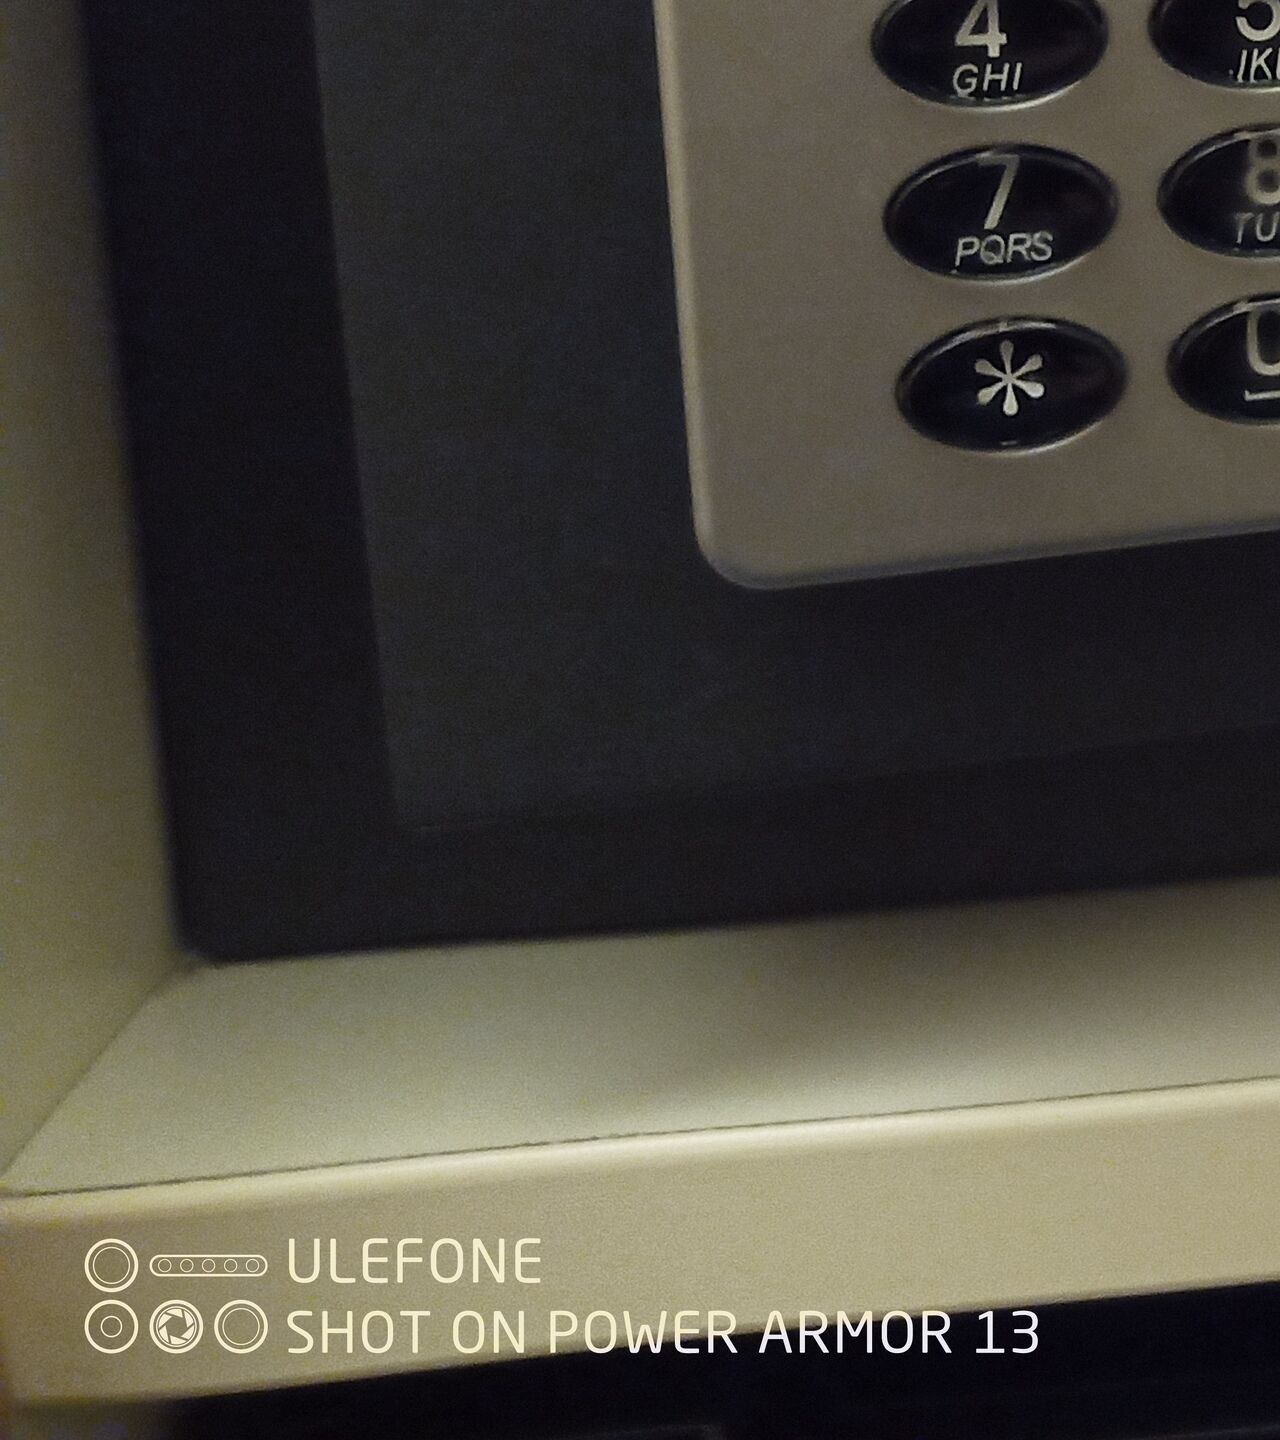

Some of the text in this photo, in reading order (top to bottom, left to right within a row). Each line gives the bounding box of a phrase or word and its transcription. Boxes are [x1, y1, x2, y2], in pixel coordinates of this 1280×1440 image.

[952, 64, 1022, 98] GHI
[976, 155, 1022, 230] 7
[955, 231, 1053, 267] PQRS
